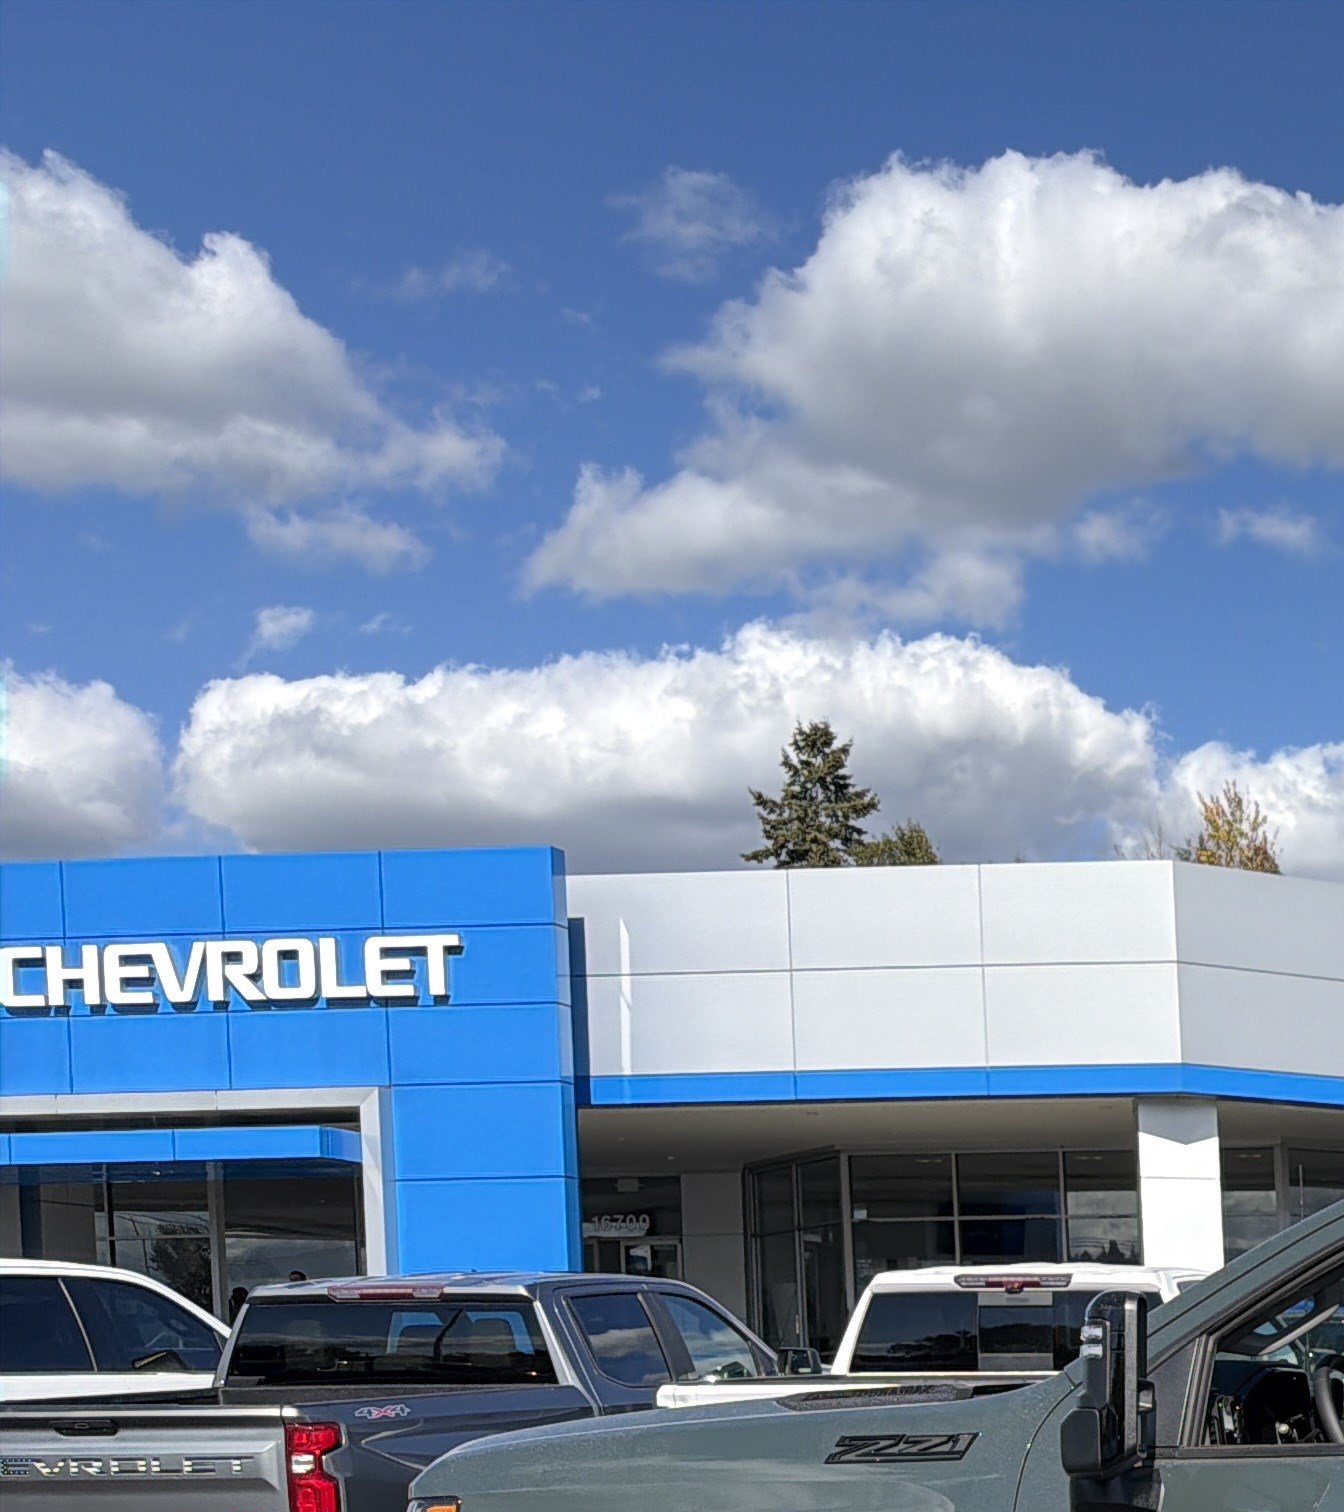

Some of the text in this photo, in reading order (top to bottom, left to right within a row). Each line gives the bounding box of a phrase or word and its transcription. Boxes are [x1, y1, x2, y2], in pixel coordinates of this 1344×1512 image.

[0, 934, 460, 1008] CHEVROLET
[592, 1213, 651, 1232] 16700
[823, 1433, 982, 1464] Z71
